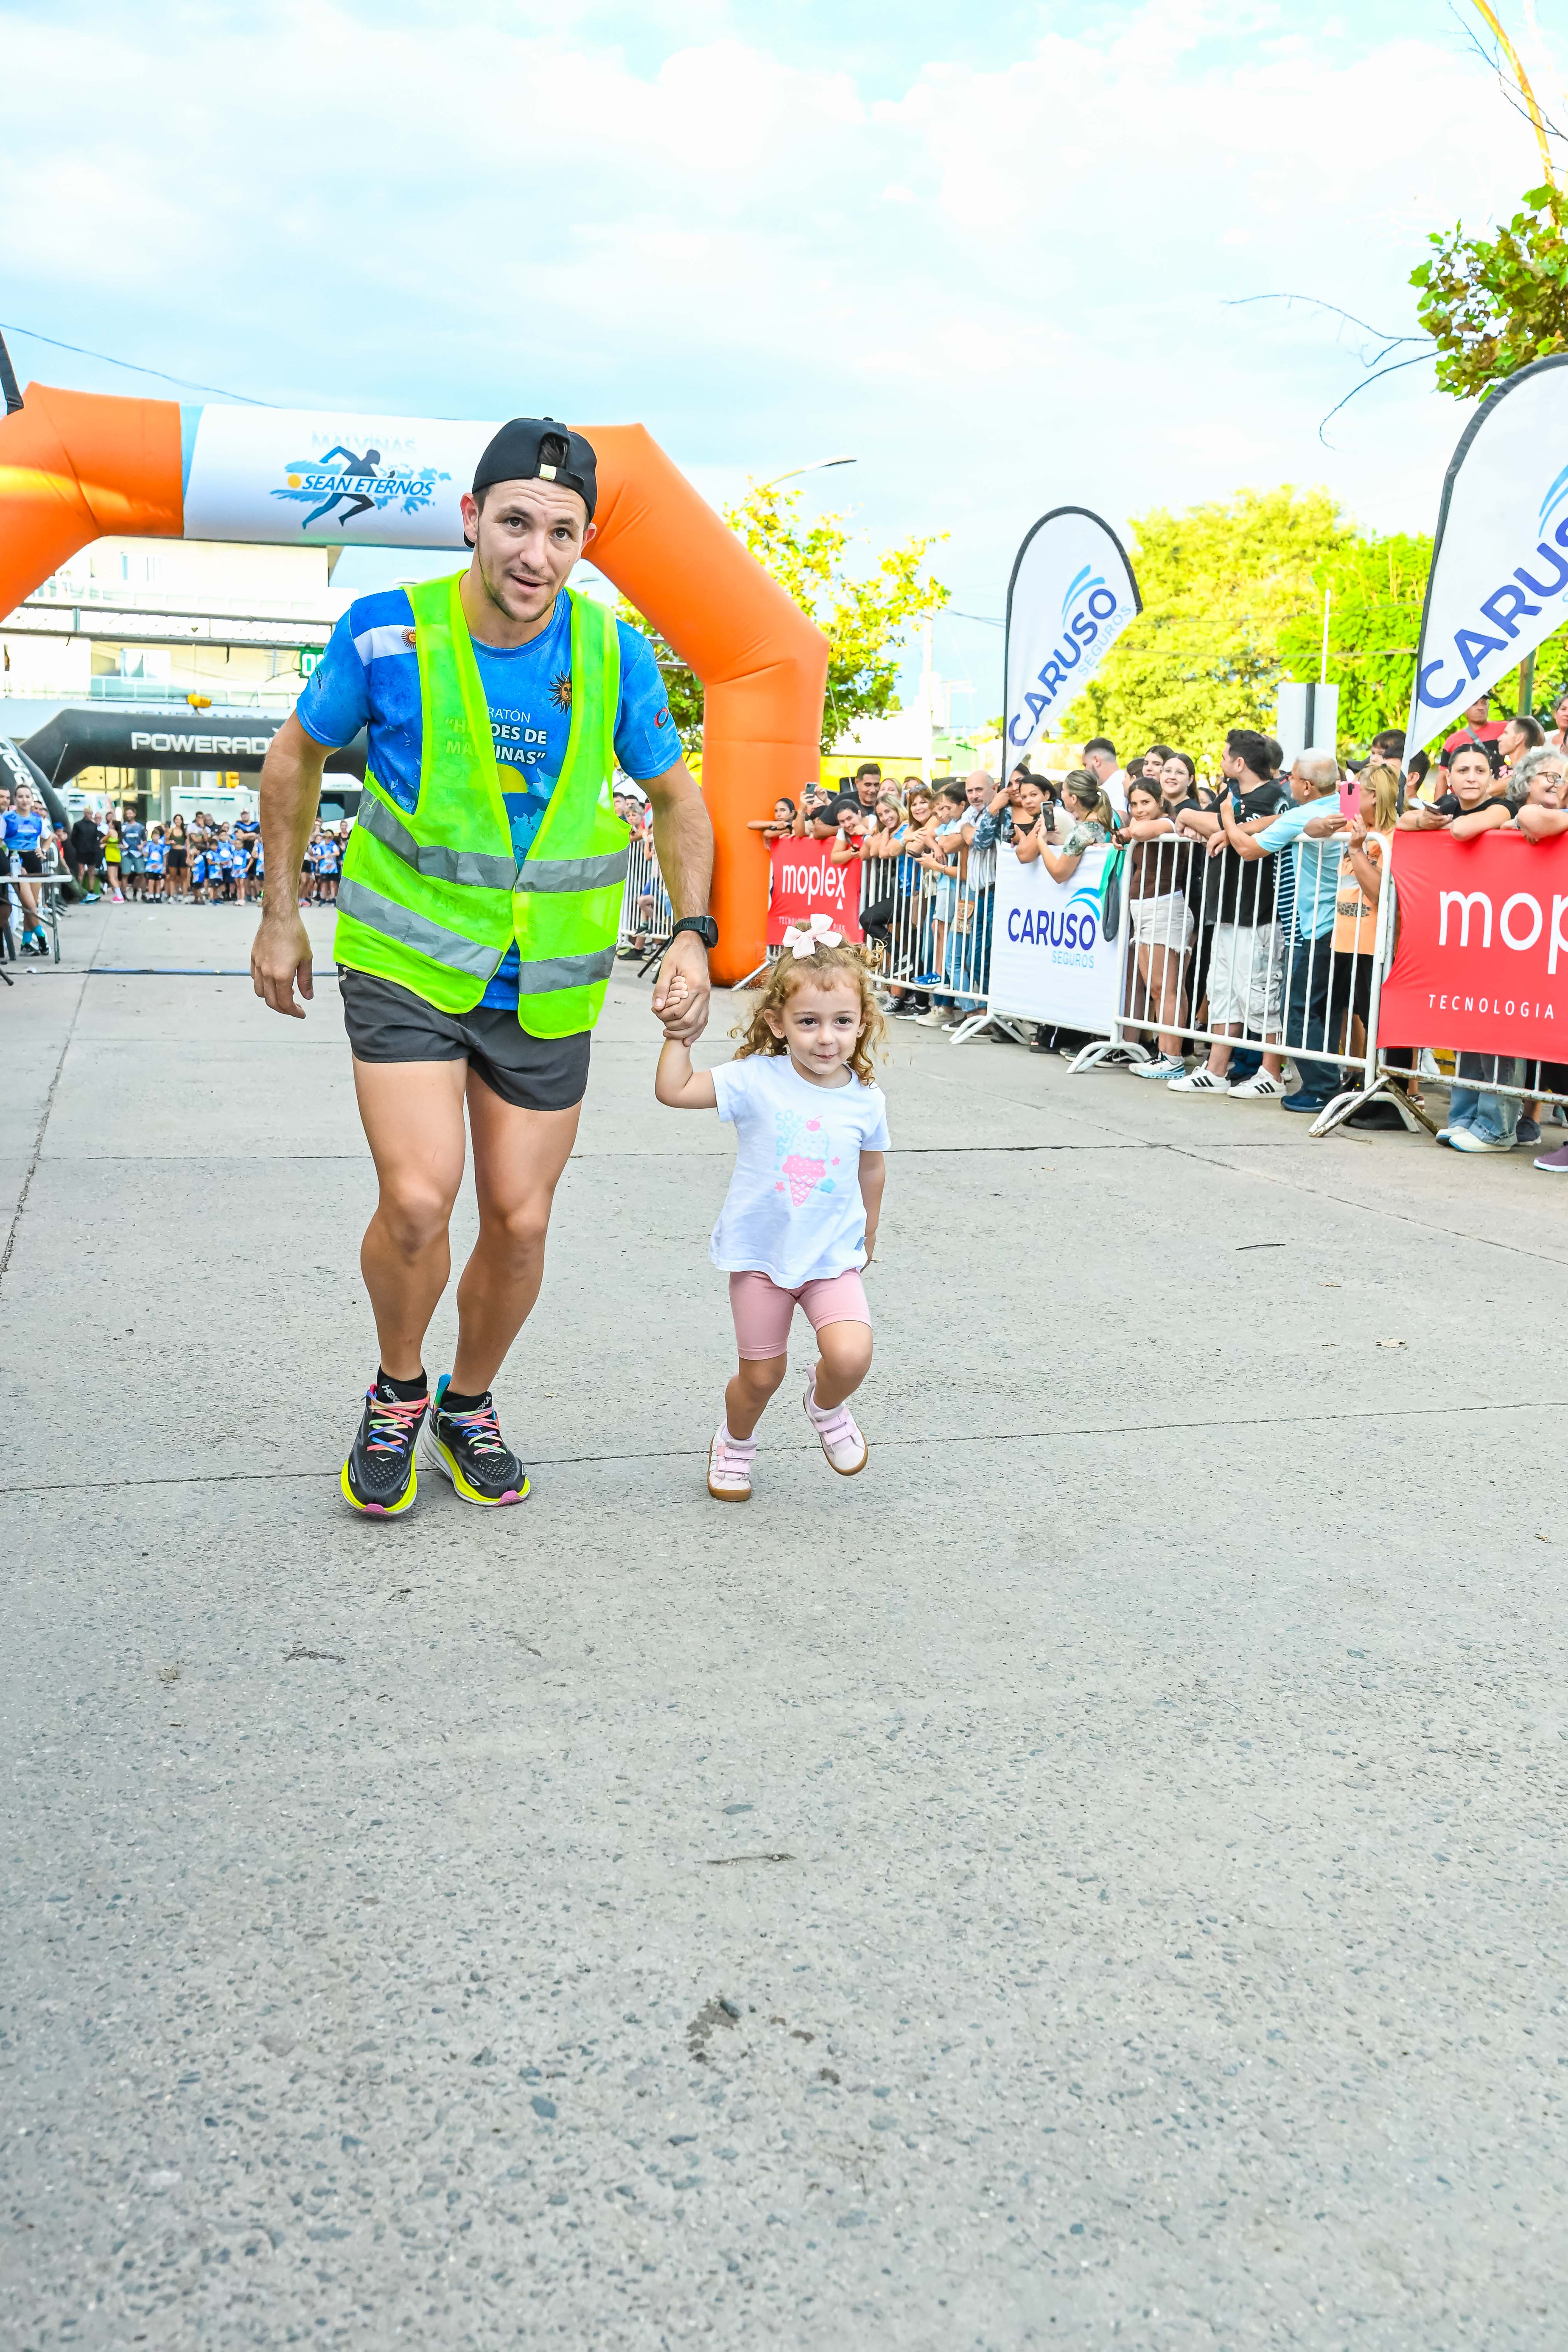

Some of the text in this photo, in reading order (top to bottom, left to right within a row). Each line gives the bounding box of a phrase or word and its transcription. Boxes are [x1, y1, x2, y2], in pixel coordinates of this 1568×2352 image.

[303, 475, 435, 496] SEAN ETERNOS
[1078, 606, 1132, 676] SEGUROS
[1008, 588, 1116, 746] CARUSO
[488, 707, 530, 723] RATÓN
[131, 732, 274, 754] POWERAD
[525, 728, 547, 744] DE
[782, 854, 848, 905] moplex
[1008, 908, 1096, 950] CARUSO
[1052, 951, 1094, 968] SEGUROS
[1429, 994, 1554, 1019] TECNOLOGIA
